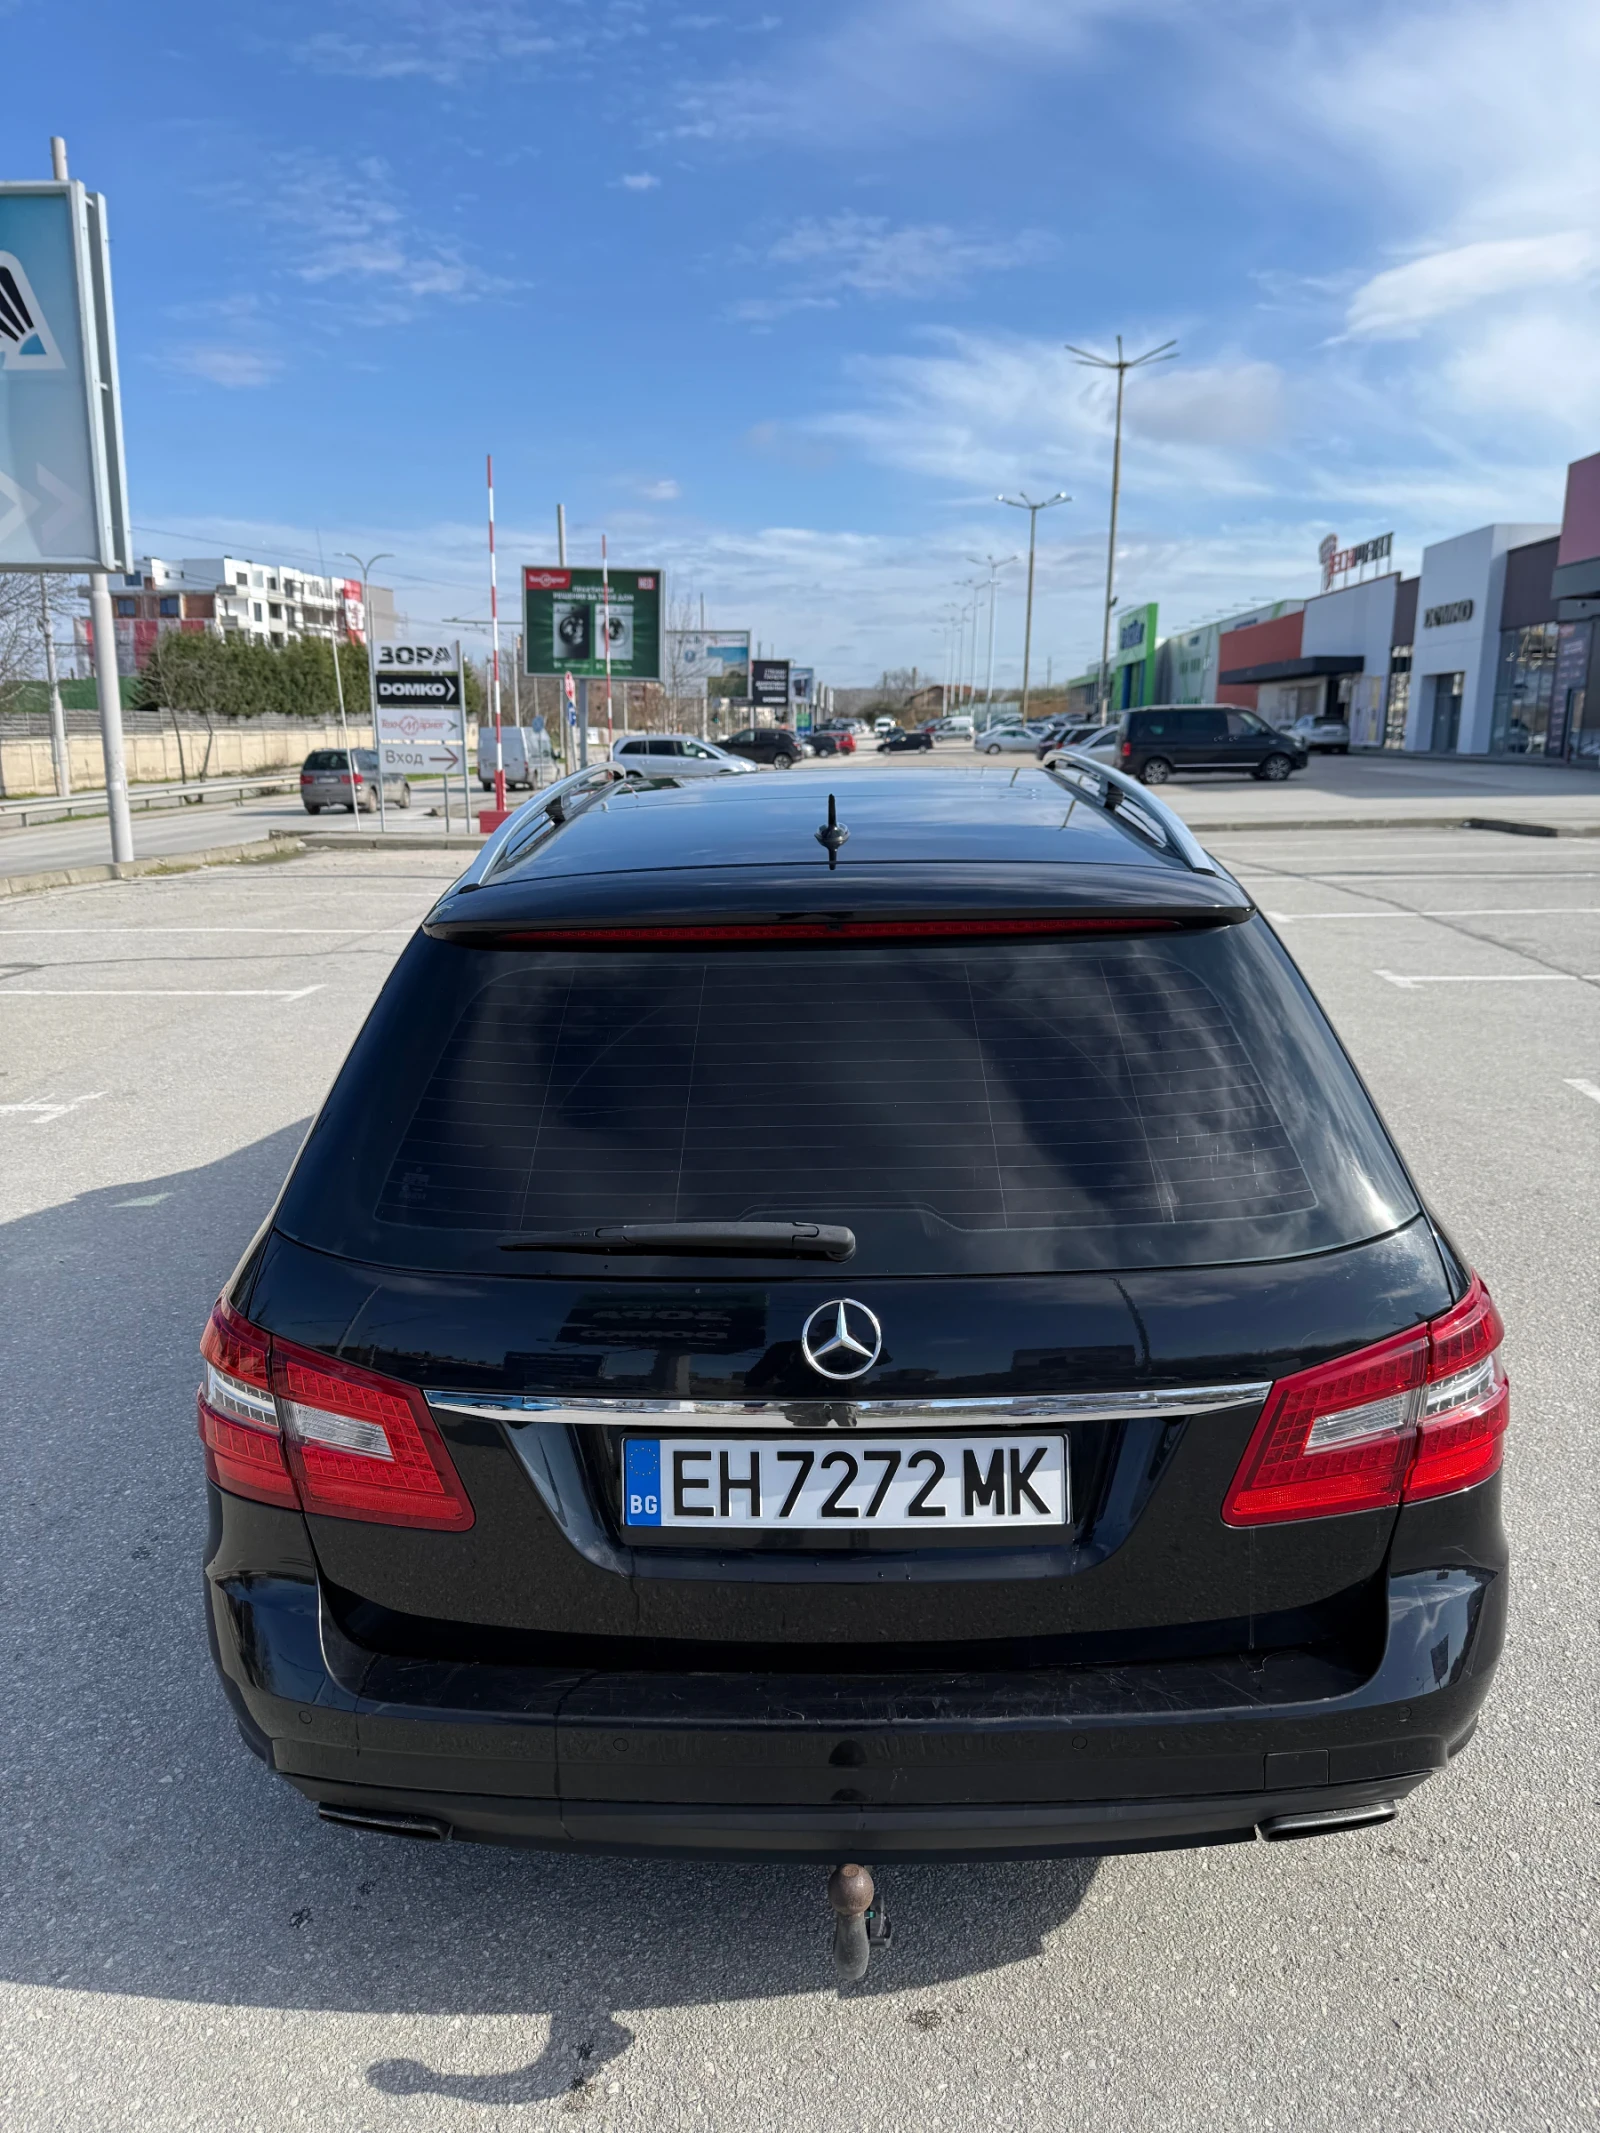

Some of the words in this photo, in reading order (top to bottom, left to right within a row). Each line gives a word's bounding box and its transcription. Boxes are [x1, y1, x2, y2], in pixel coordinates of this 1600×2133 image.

[379, 646, 452, 665] ЗОРА
[380, 683, 446, 697] DOMKO
[385, 750, 424, 765] Вход
[673, 1450, 761, 1517] EH
[777, 1450, 947, 1518] 7272
[963, 1447, 1052, 1517] MK
[630, 1494, 658, 1515] BG
